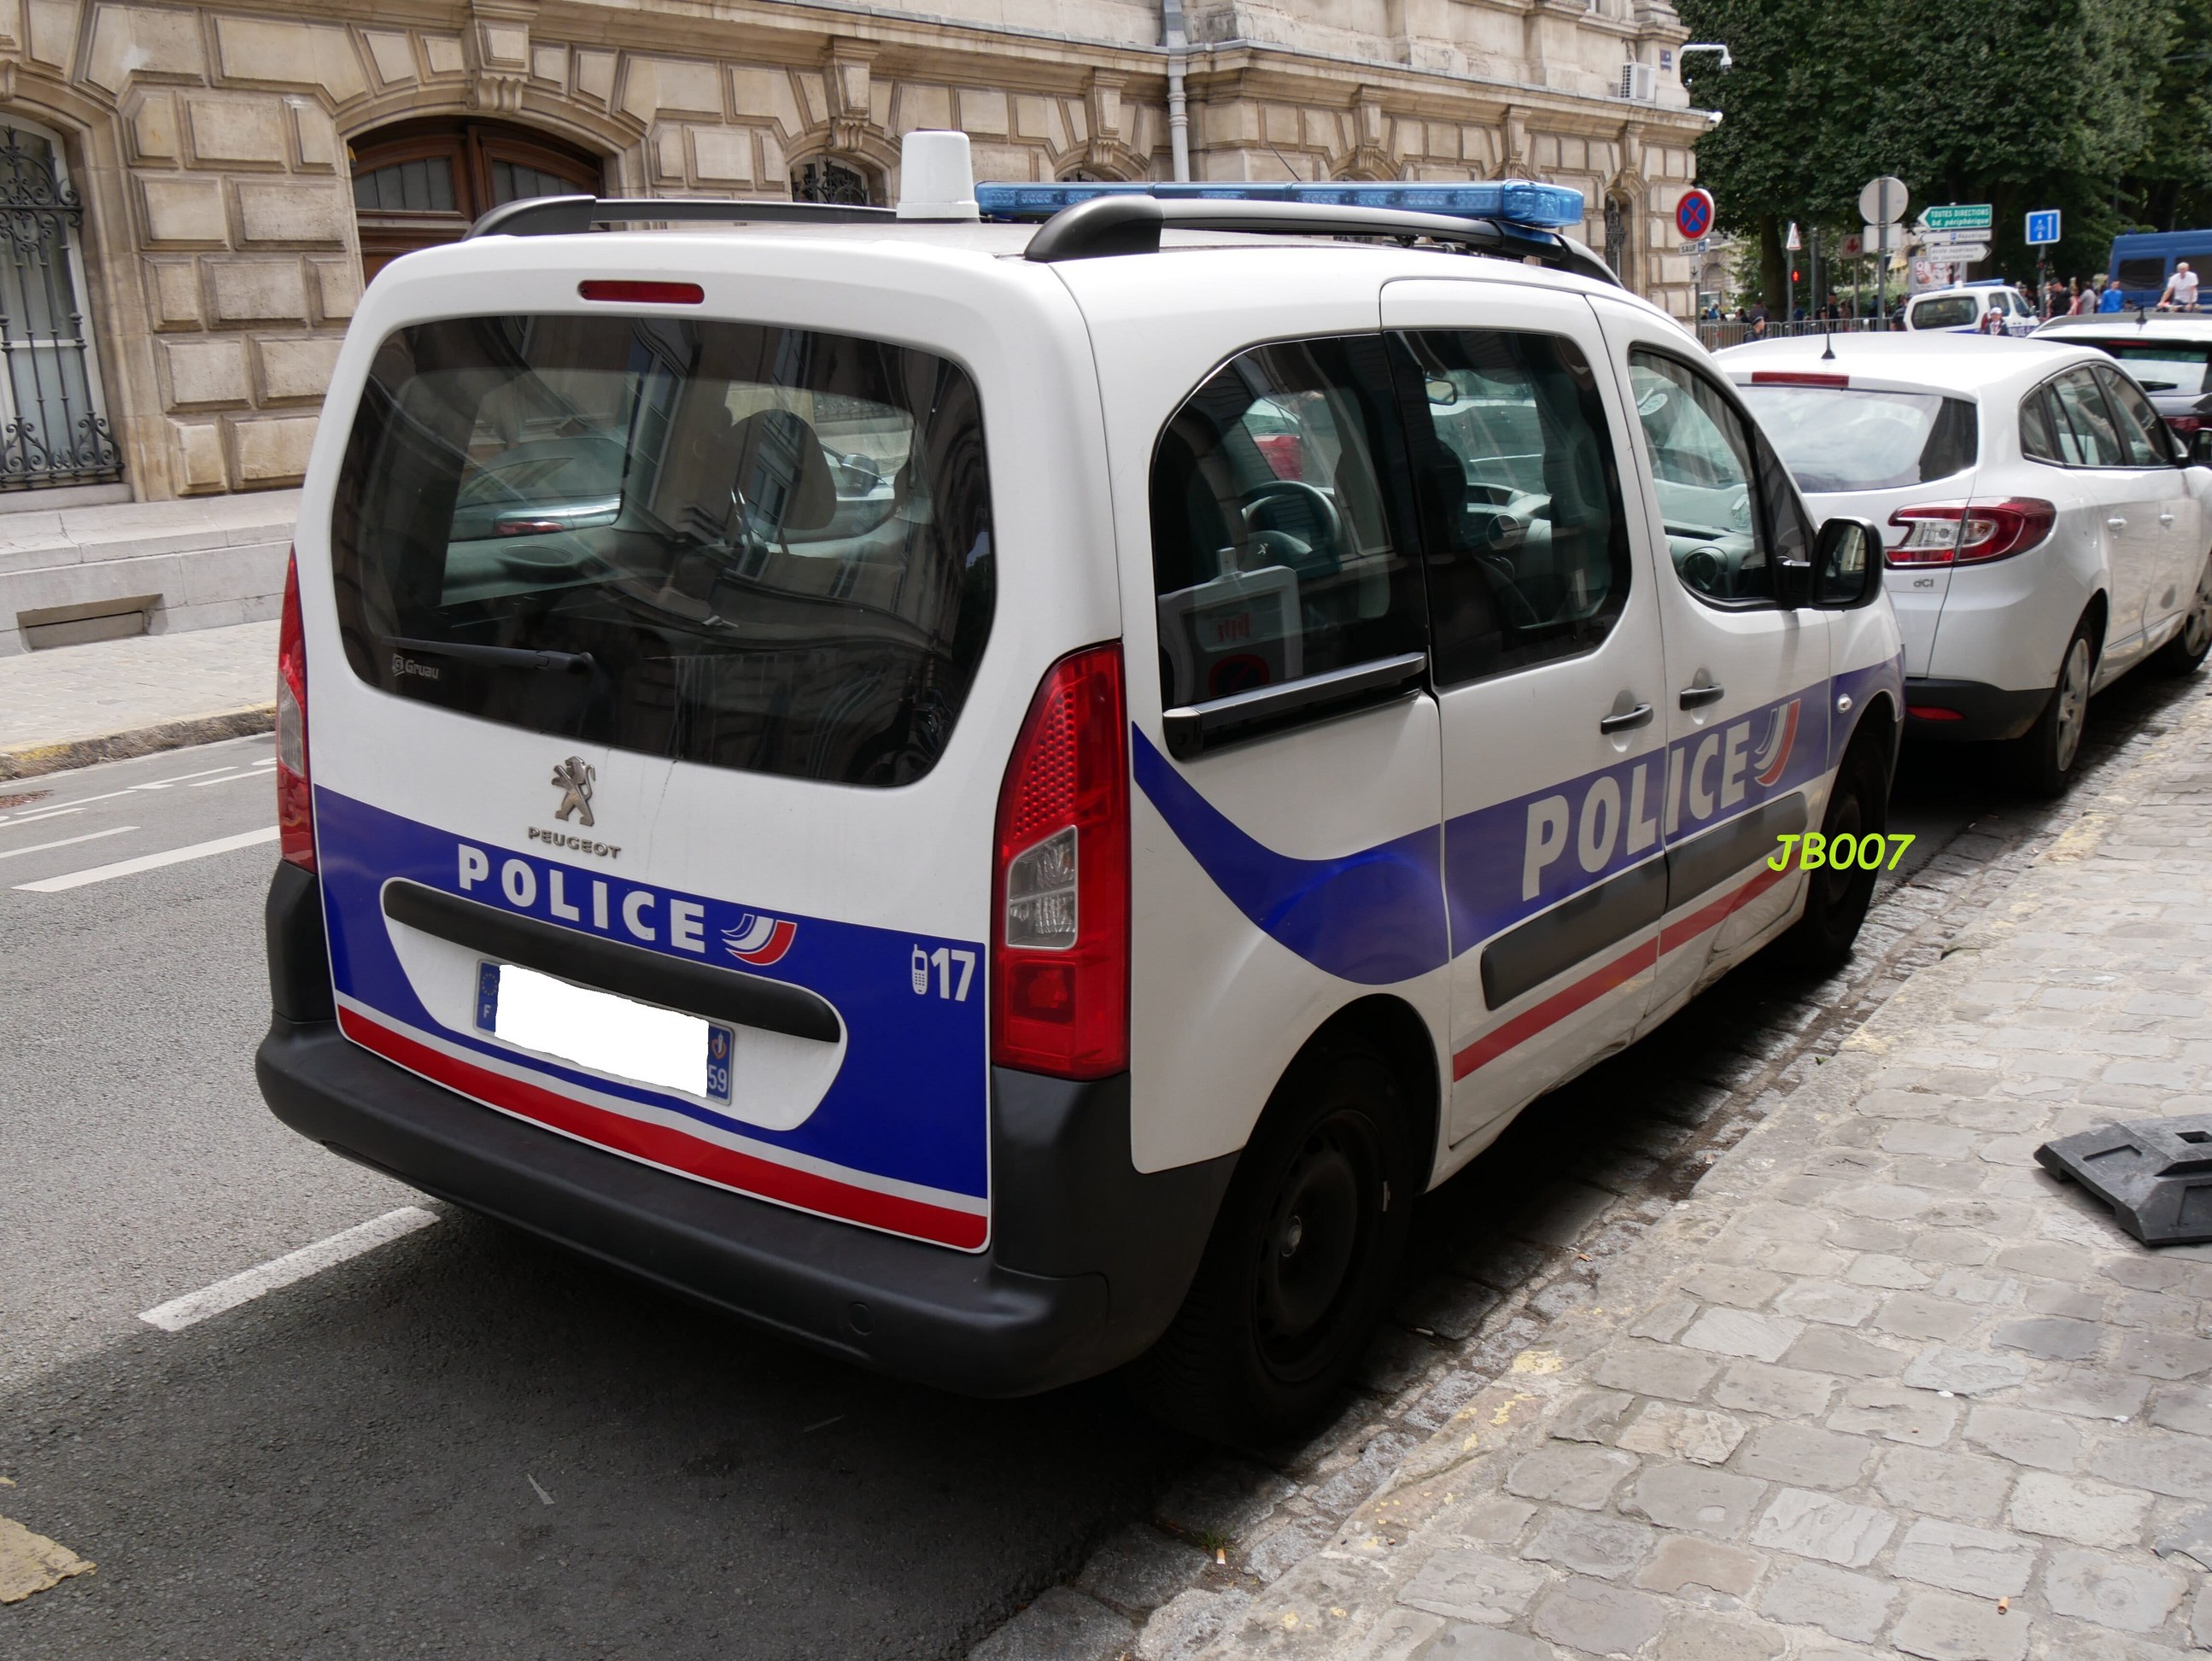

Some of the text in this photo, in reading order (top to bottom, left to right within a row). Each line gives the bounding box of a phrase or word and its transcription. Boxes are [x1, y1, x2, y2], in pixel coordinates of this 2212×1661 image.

[1953, 208, 1989, 217] DIRECTIONS
[1681, 244, 1696, 253] SAUF
[405, 659, 439, 679] Gruau
[1522, 720, 1752, 902] POLICE
[528, 826, 622, 859] PEUGEOT
[458, 843, 705, 954] POLICE
[930, 947, 975, 1002] 17
[483, 1003, 491, 1019] F
[707, 1063, 728, 1093] 59
